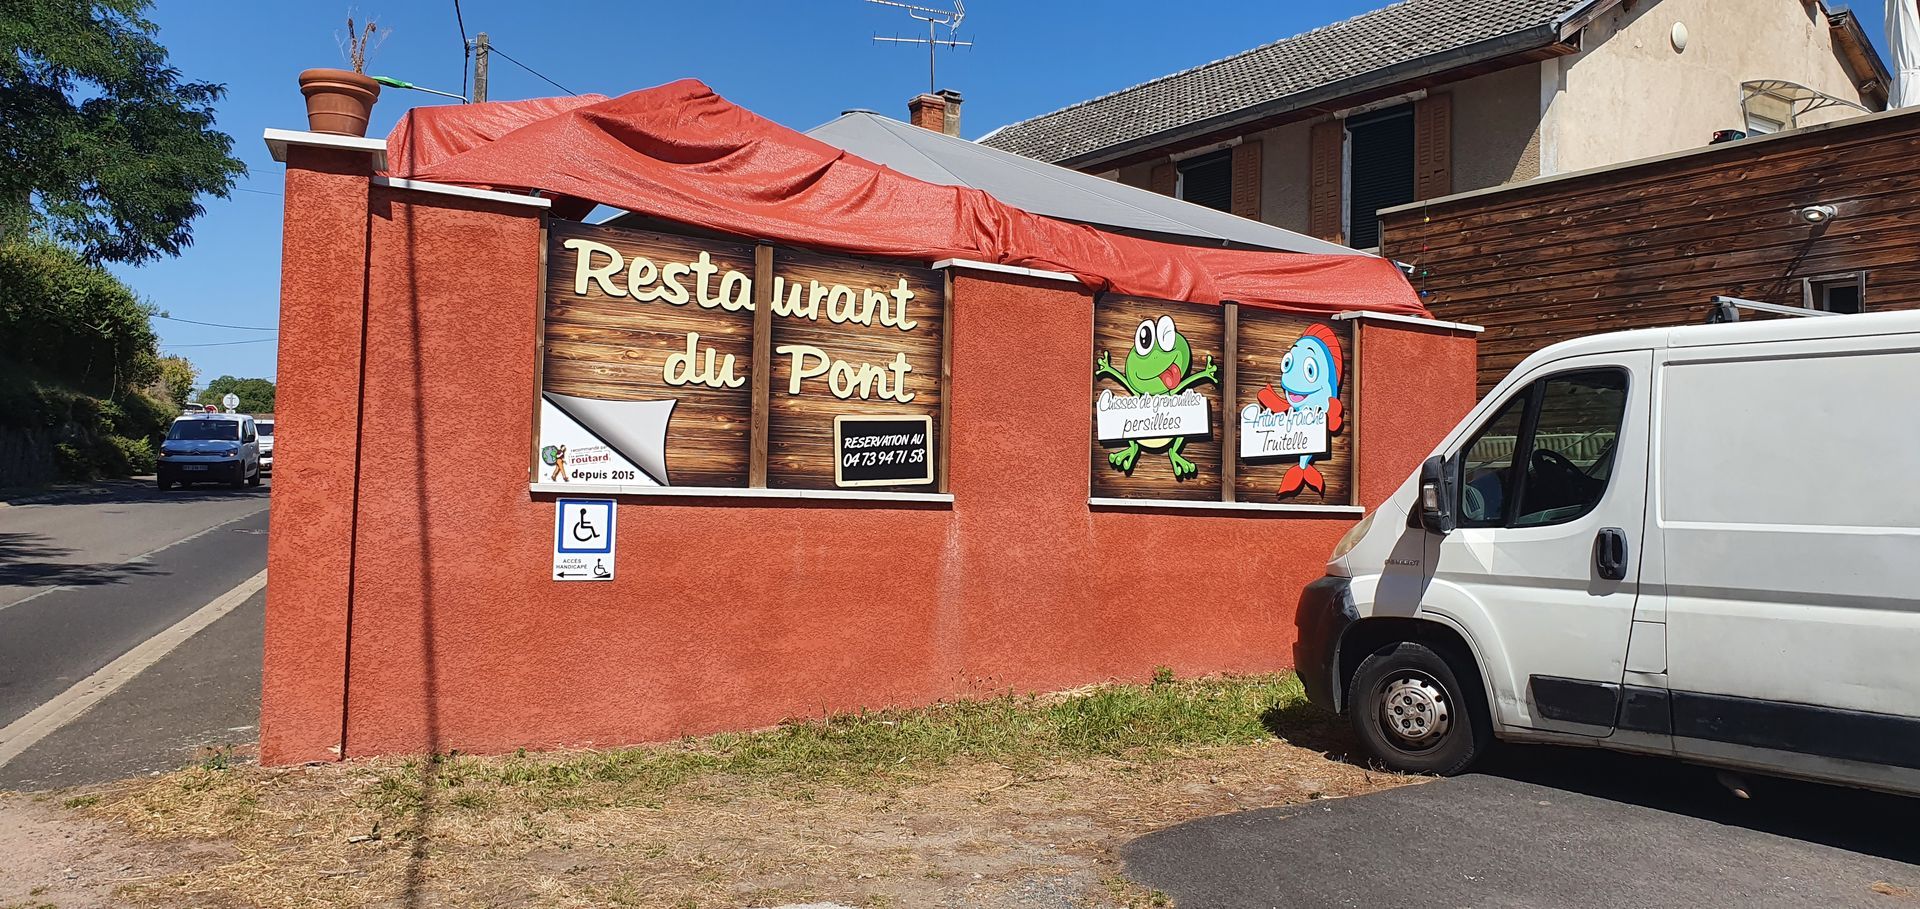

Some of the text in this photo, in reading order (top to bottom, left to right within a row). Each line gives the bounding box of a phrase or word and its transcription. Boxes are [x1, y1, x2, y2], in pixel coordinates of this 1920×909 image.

[563, 238, 918, 331] Restaurant
[663, 331, 916, 403] du Pont
[1100, 389, 1201, 413] Cuisses de grenouilles
[1122, 412, 1182, 438] persillées
[844, 433, 924, 448] RESERVATION AU
[1256, 430, 1308, 452] Truitelle
[571, 453, 609, 464] routard
[843, 448, 925, 467] 04 73 94 71 58
[571, 469, 635, 481] depuis 2015
